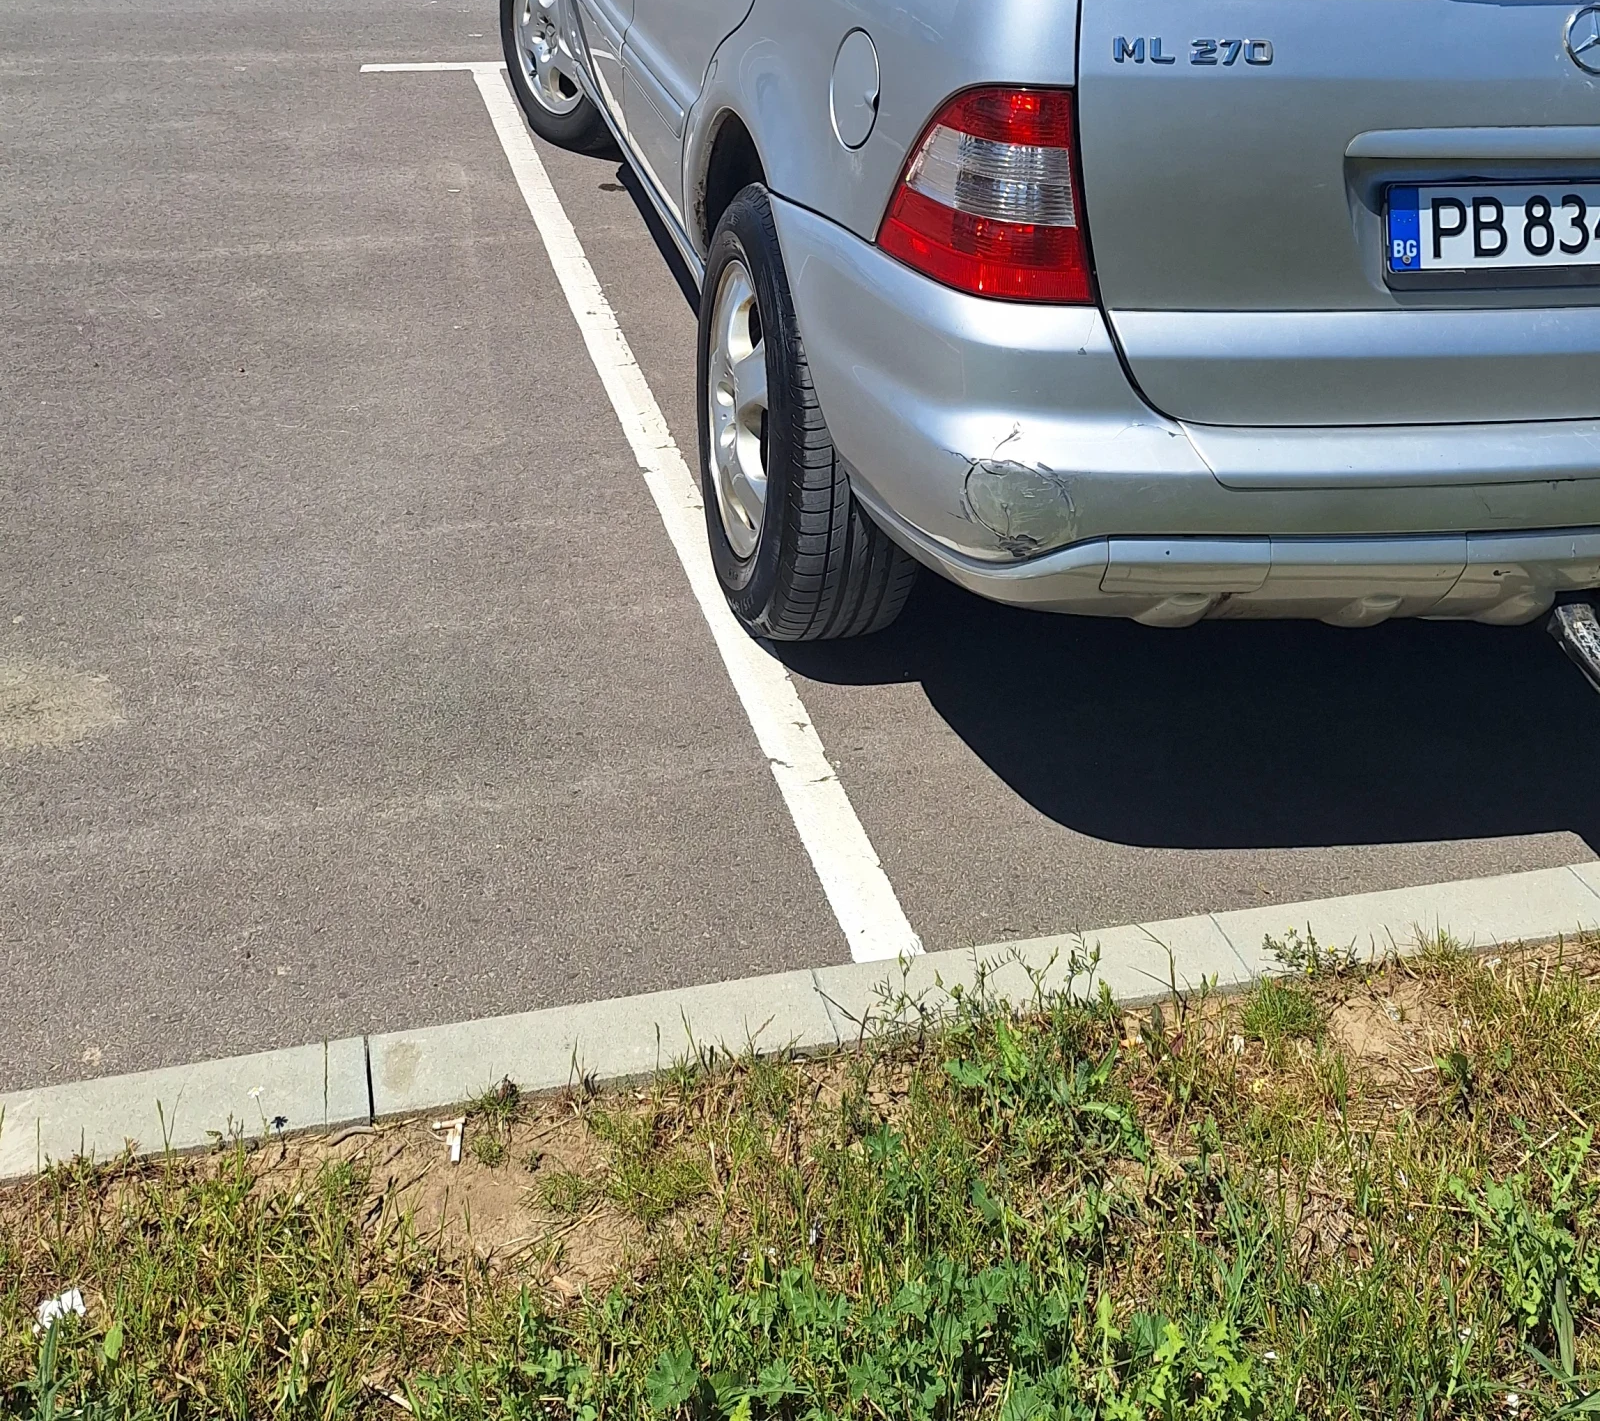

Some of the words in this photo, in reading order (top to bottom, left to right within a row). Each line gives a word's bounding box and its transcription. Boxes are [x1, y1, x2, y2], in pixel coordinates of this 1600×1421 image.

[1113, 36, 1176, 64] ML
[1190, 38, 1274, 66] 270
[1431, 196, 1508, 259] PB
[1523, 194, 1600, 257] 83
[1393, 239, 1418, 258] BG
